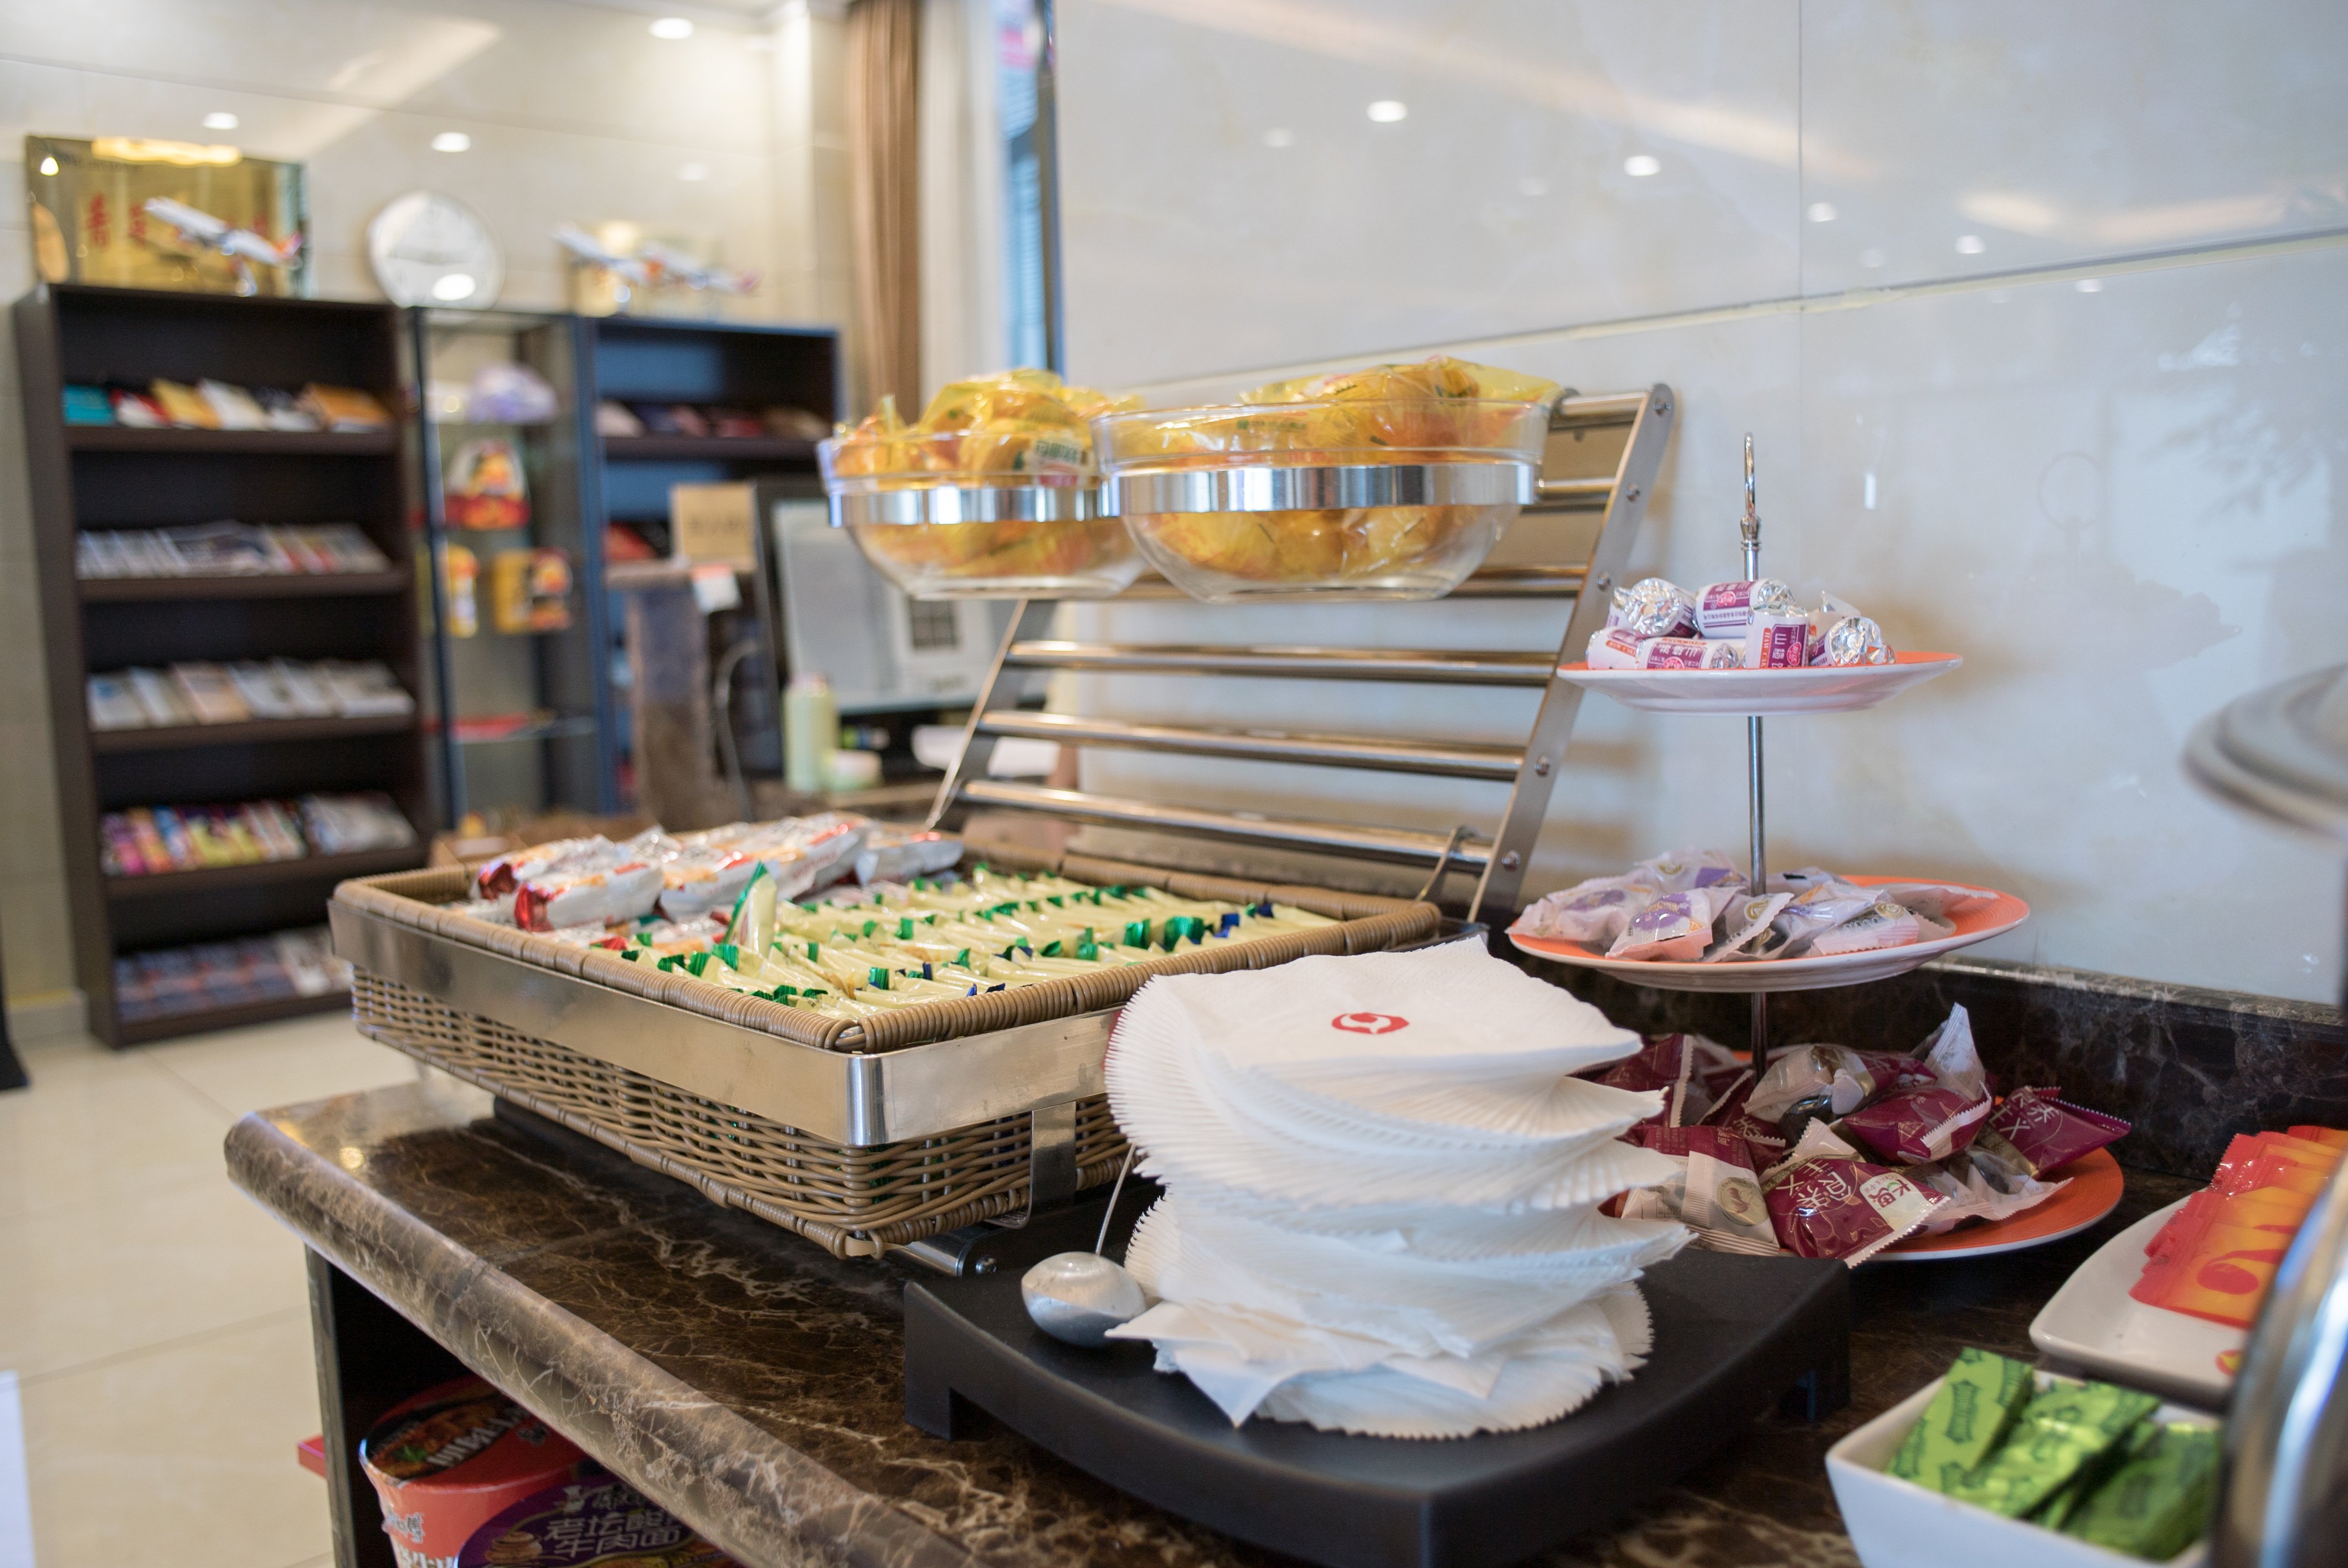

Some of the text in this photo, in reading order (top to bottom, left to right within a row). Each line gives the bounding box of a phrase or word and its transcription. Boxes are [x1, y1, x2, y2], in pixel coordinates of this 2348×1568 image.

[1775, 1159, 1829, 1196] 主义
[1796, 1171, 1851, 1209] 食养
[554, 1526, 682, 1559] 牛肉面
